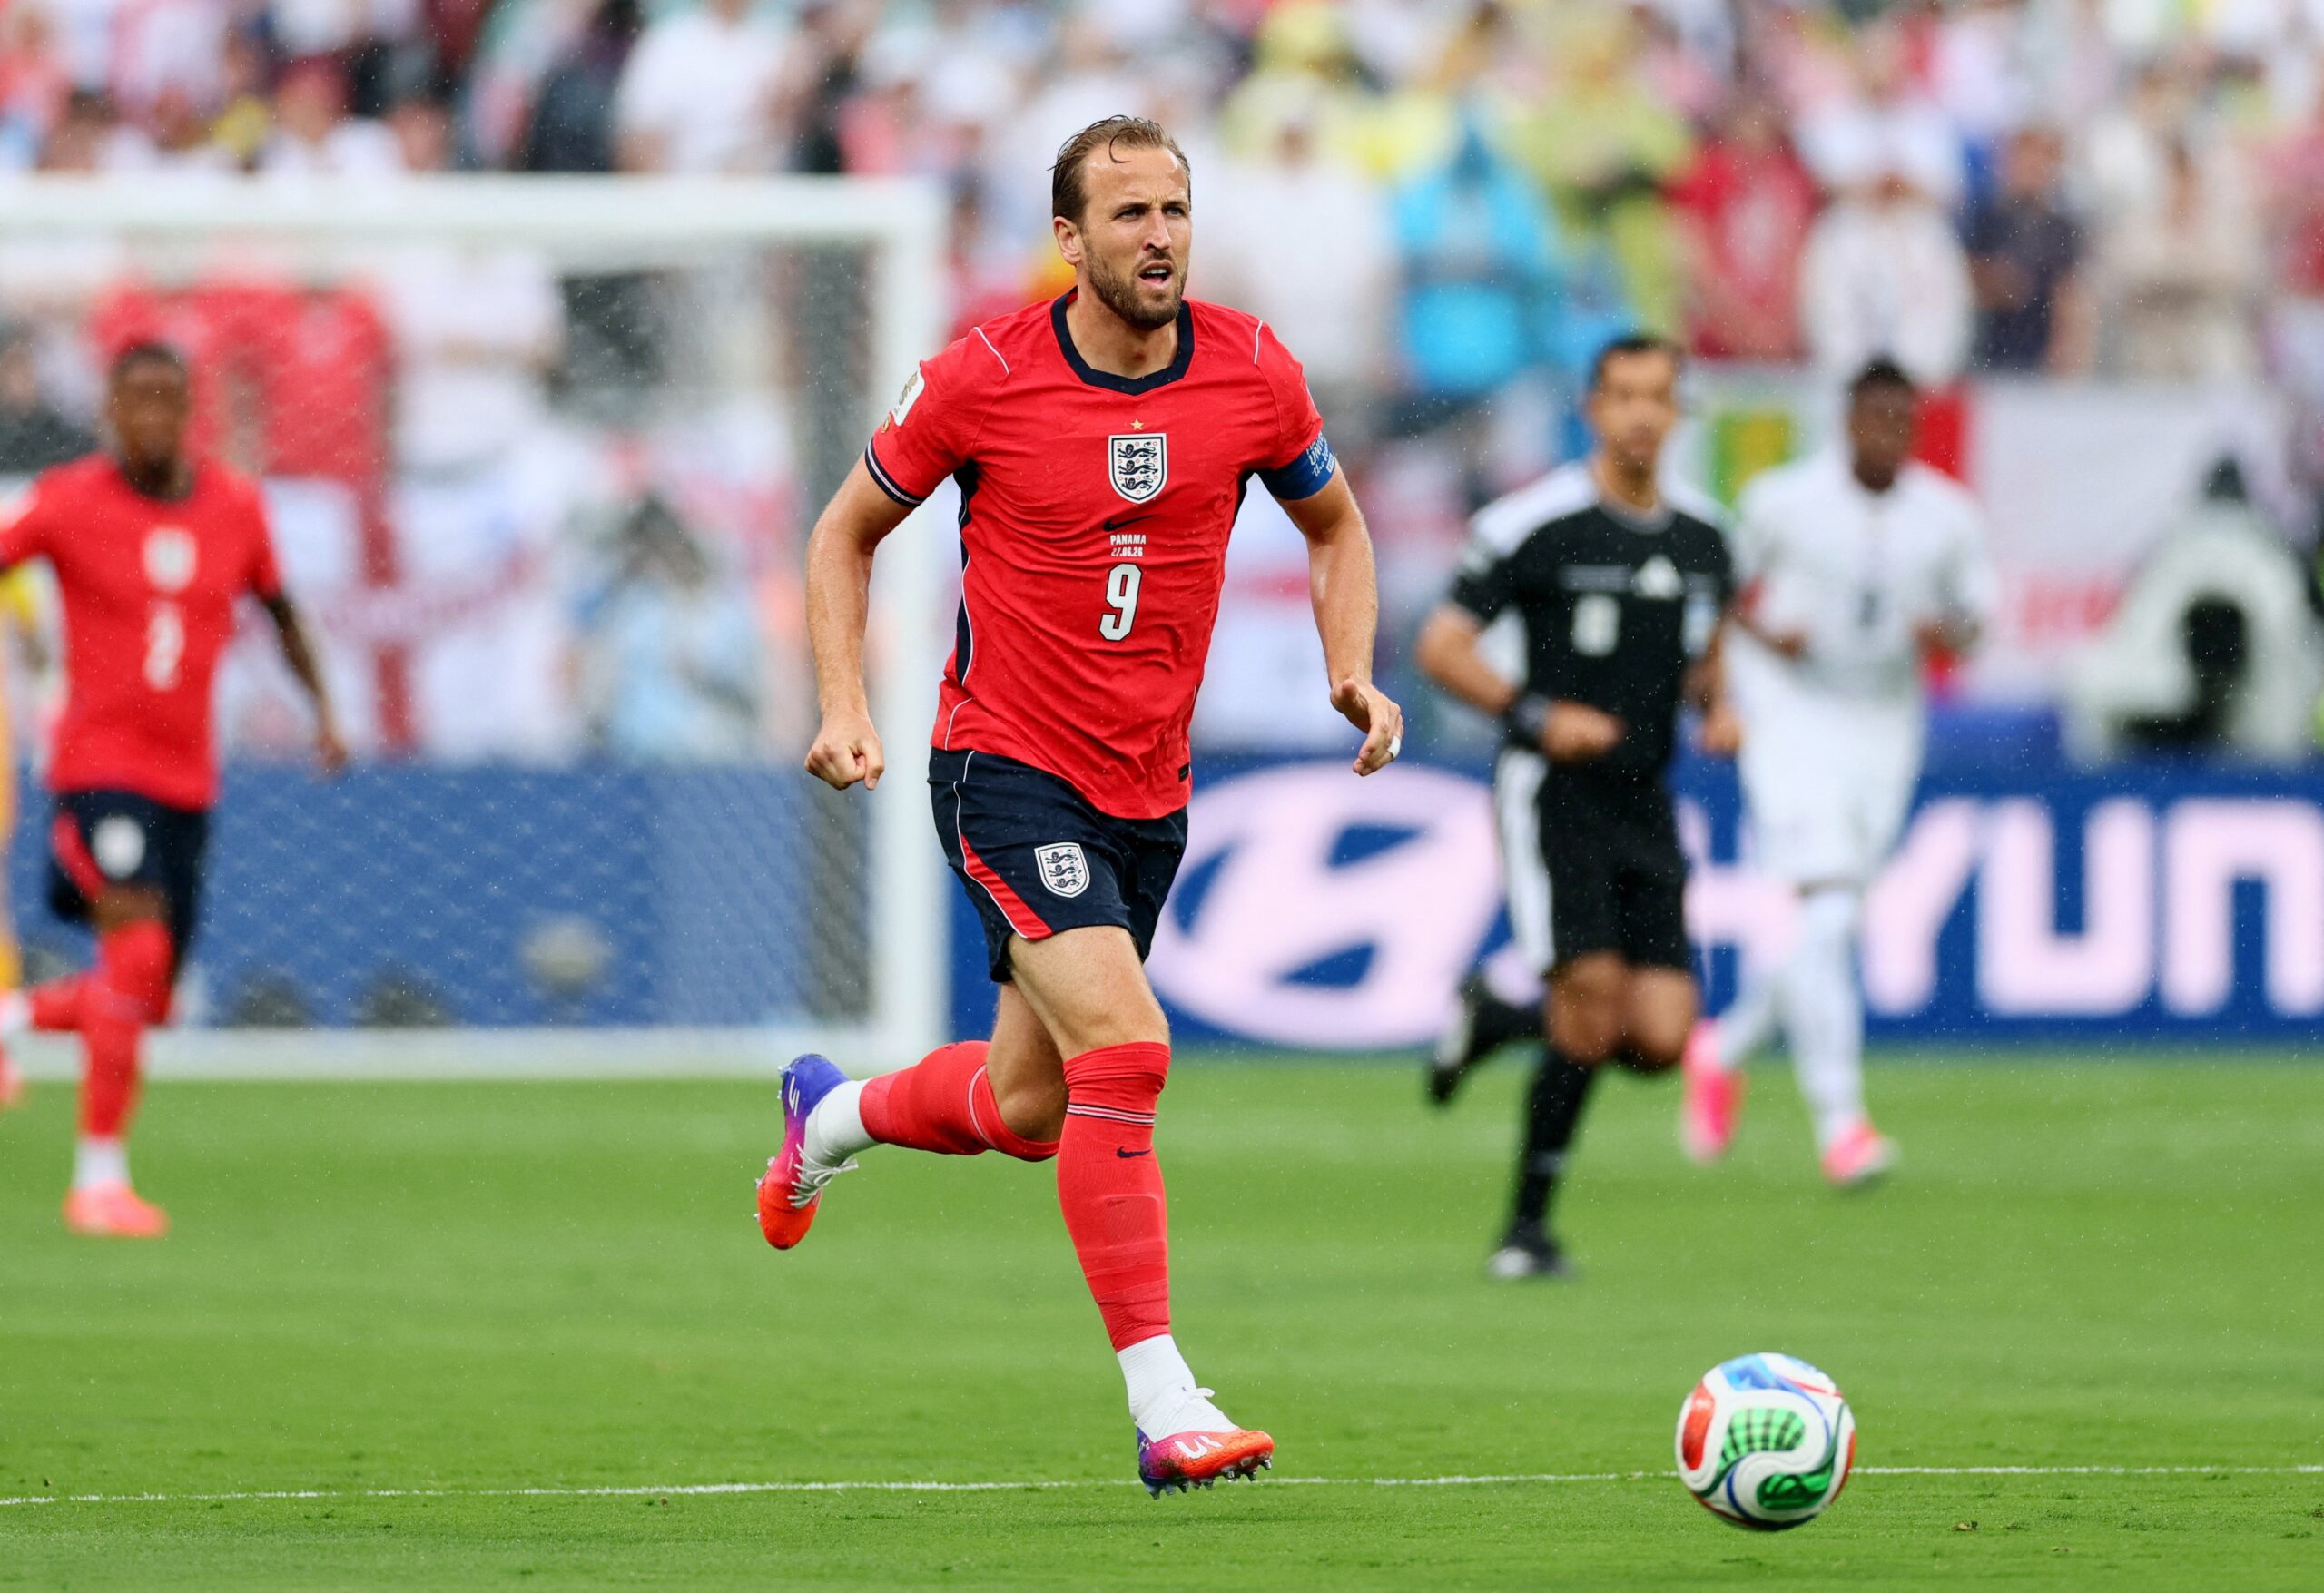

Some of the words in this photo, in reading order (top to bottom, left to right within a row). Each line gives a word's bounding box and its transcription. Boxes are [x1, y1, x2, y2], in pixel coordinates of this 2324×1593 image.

[1110, 534, 1146, 546] PANAMA
[1110, 546, 1144, 557] 27.06.26
[1098, 563, 1143, 642] 9
